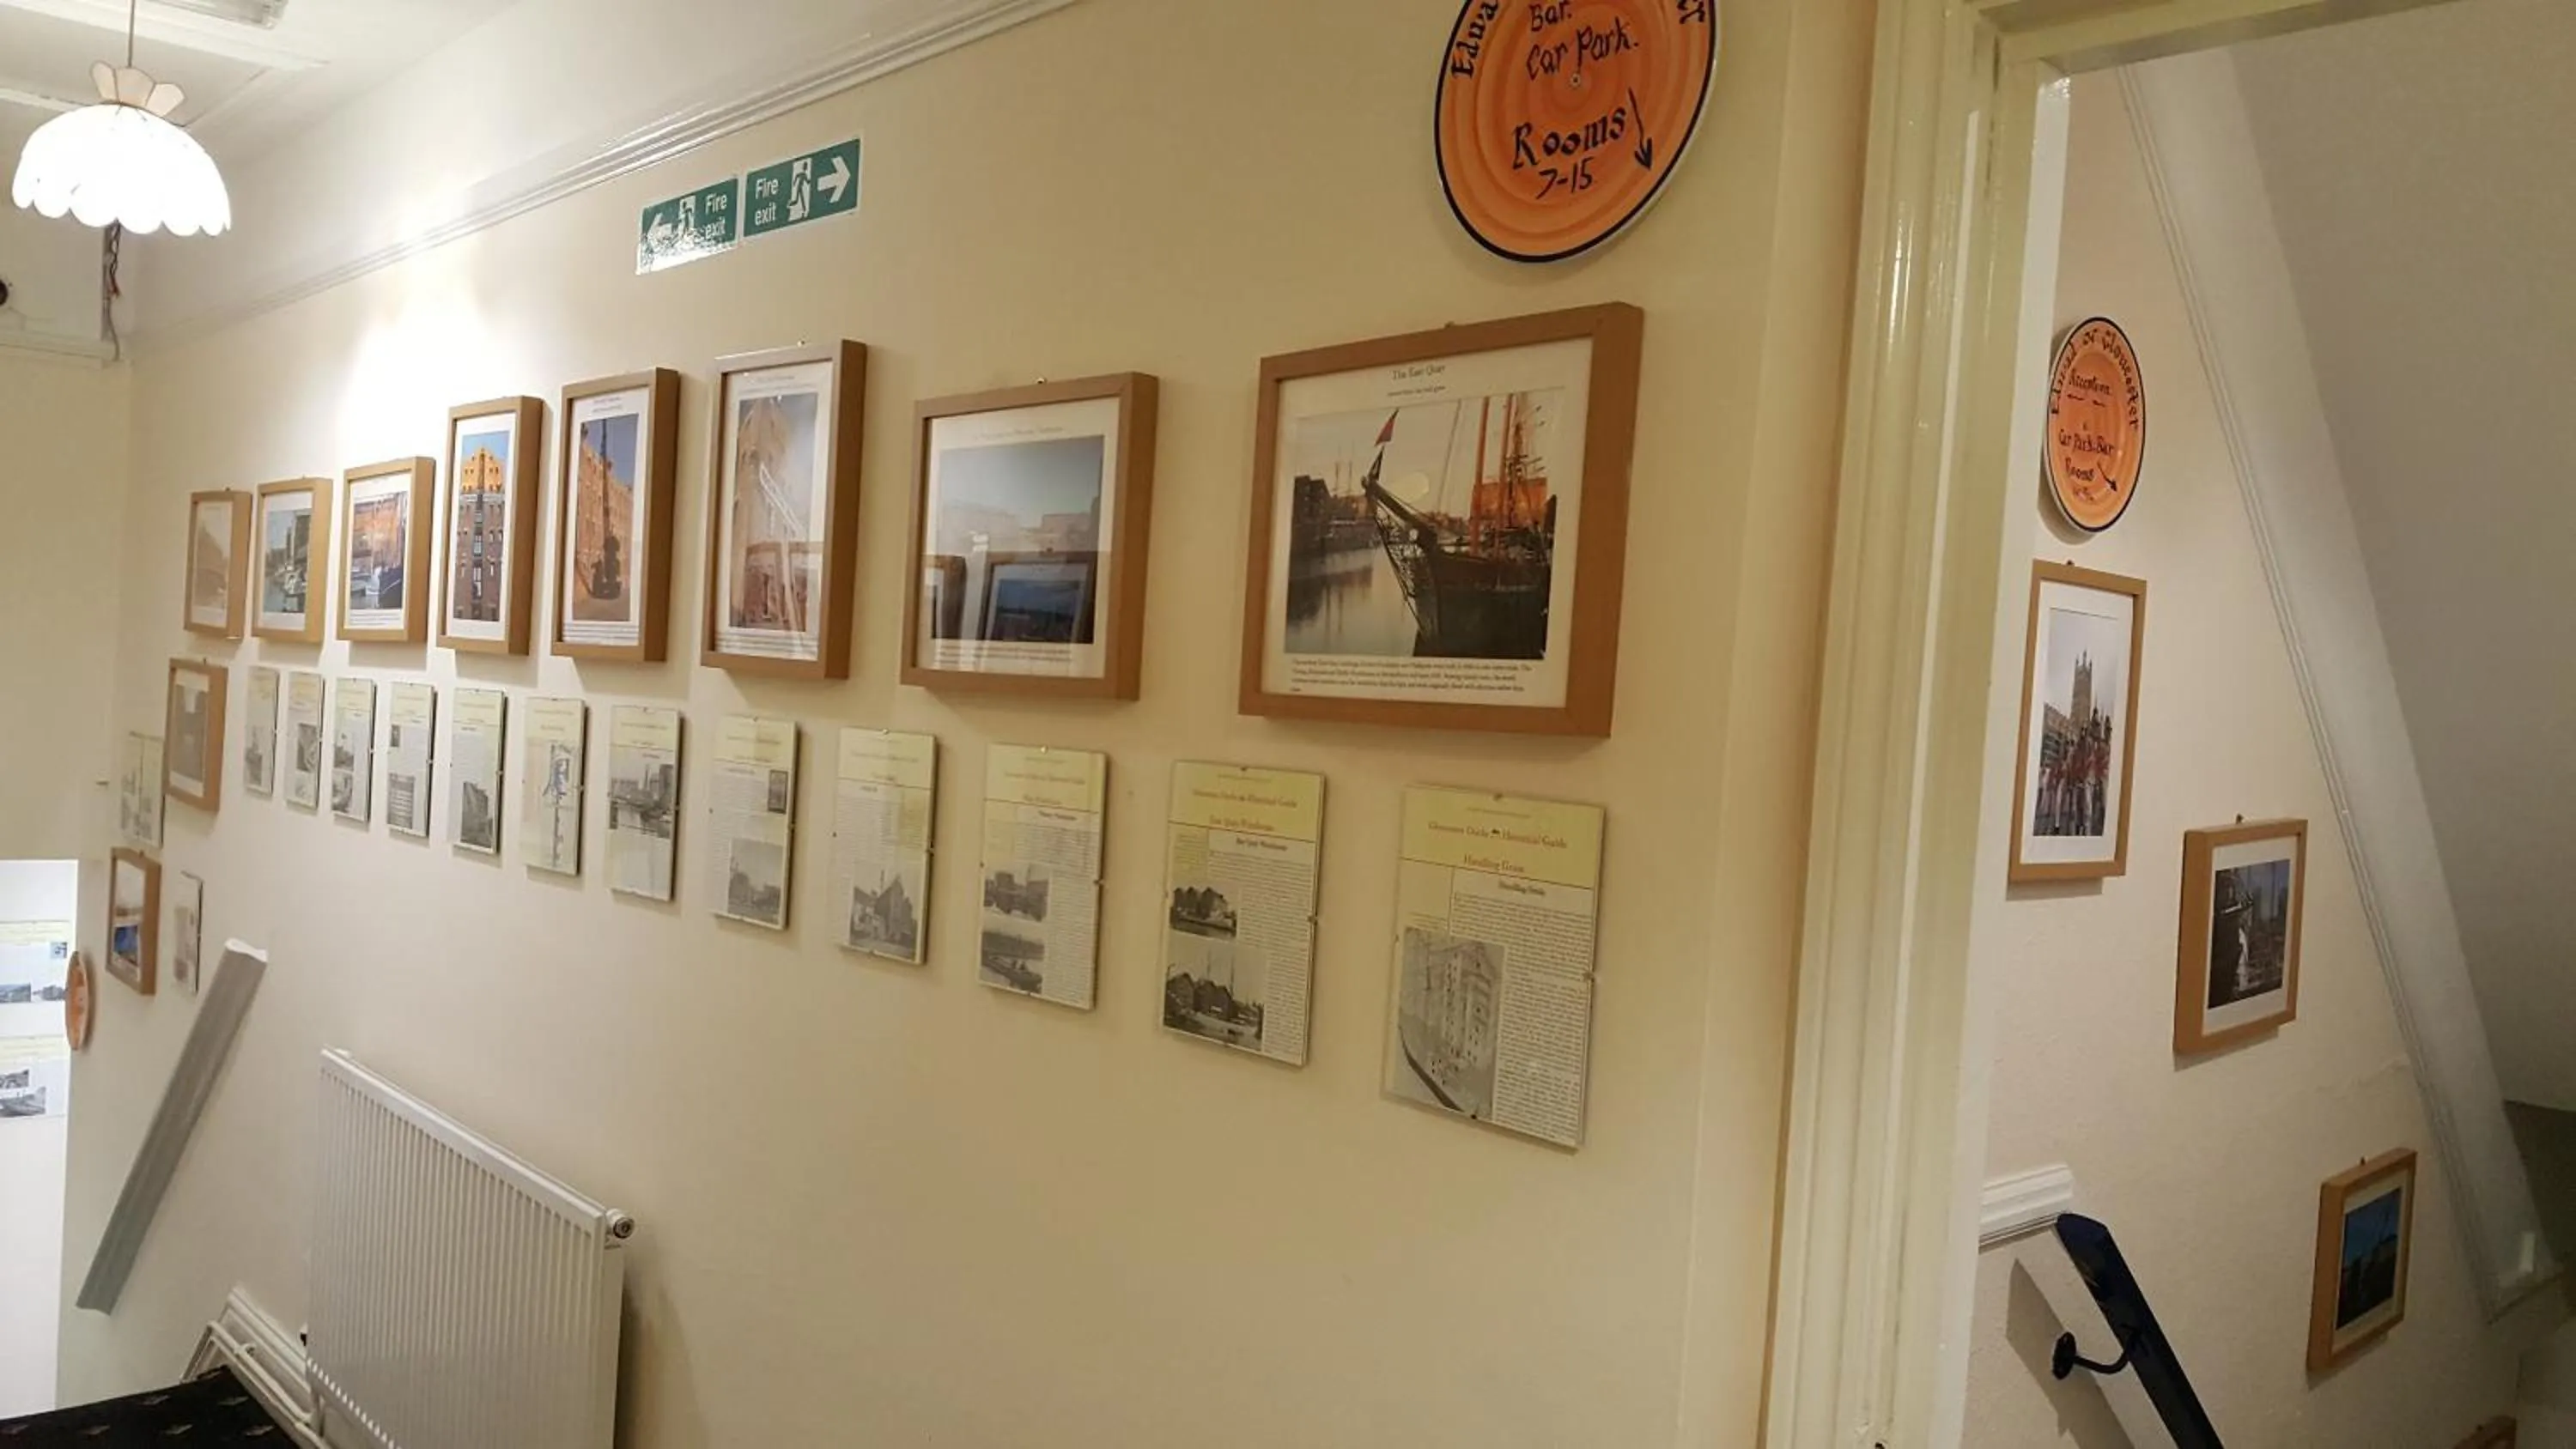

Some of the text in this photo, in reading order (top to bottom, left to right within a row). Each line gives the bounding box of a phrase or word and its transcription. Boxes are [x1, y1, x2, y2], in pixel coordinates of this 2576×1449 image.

[1449, 0, 1499, 79] Edwa
[1526, 43, 1570, 81] Car
[1512, 106, 1628, 170] Rooms
[755, 178, 779, 199] Fire
[1535, 155, 1595, 199] 7-15
[705, 192, 727, 214] Fire
[755, 203, 776, 226] exit
[704, 217, 726, 239] exit
